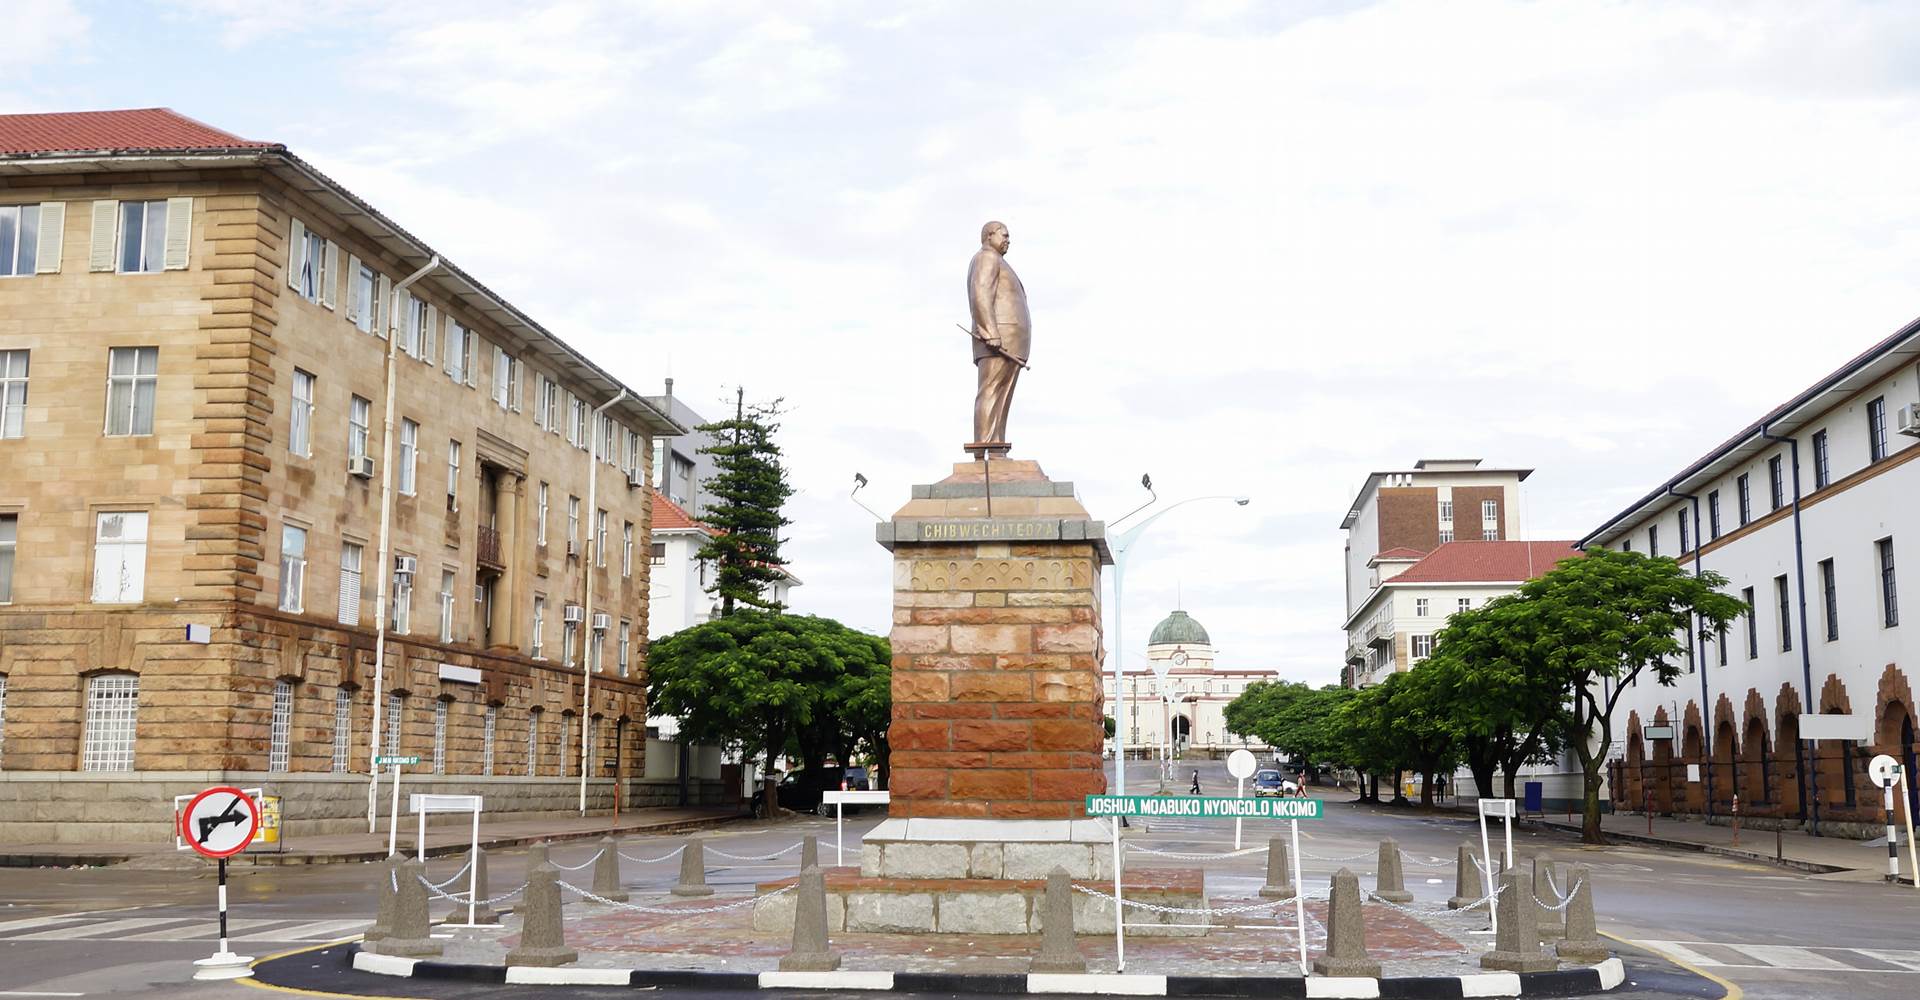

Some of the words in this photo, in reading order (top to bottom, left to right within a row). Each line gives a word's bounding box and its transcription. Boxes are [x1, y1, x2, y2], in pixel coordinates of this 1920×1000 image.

[1087, 798, 1137, 814] JOSHUA
[1203, 800, 1270, 816] NYONGOLO
[1272, 801, 1317, 817] NKOMO
